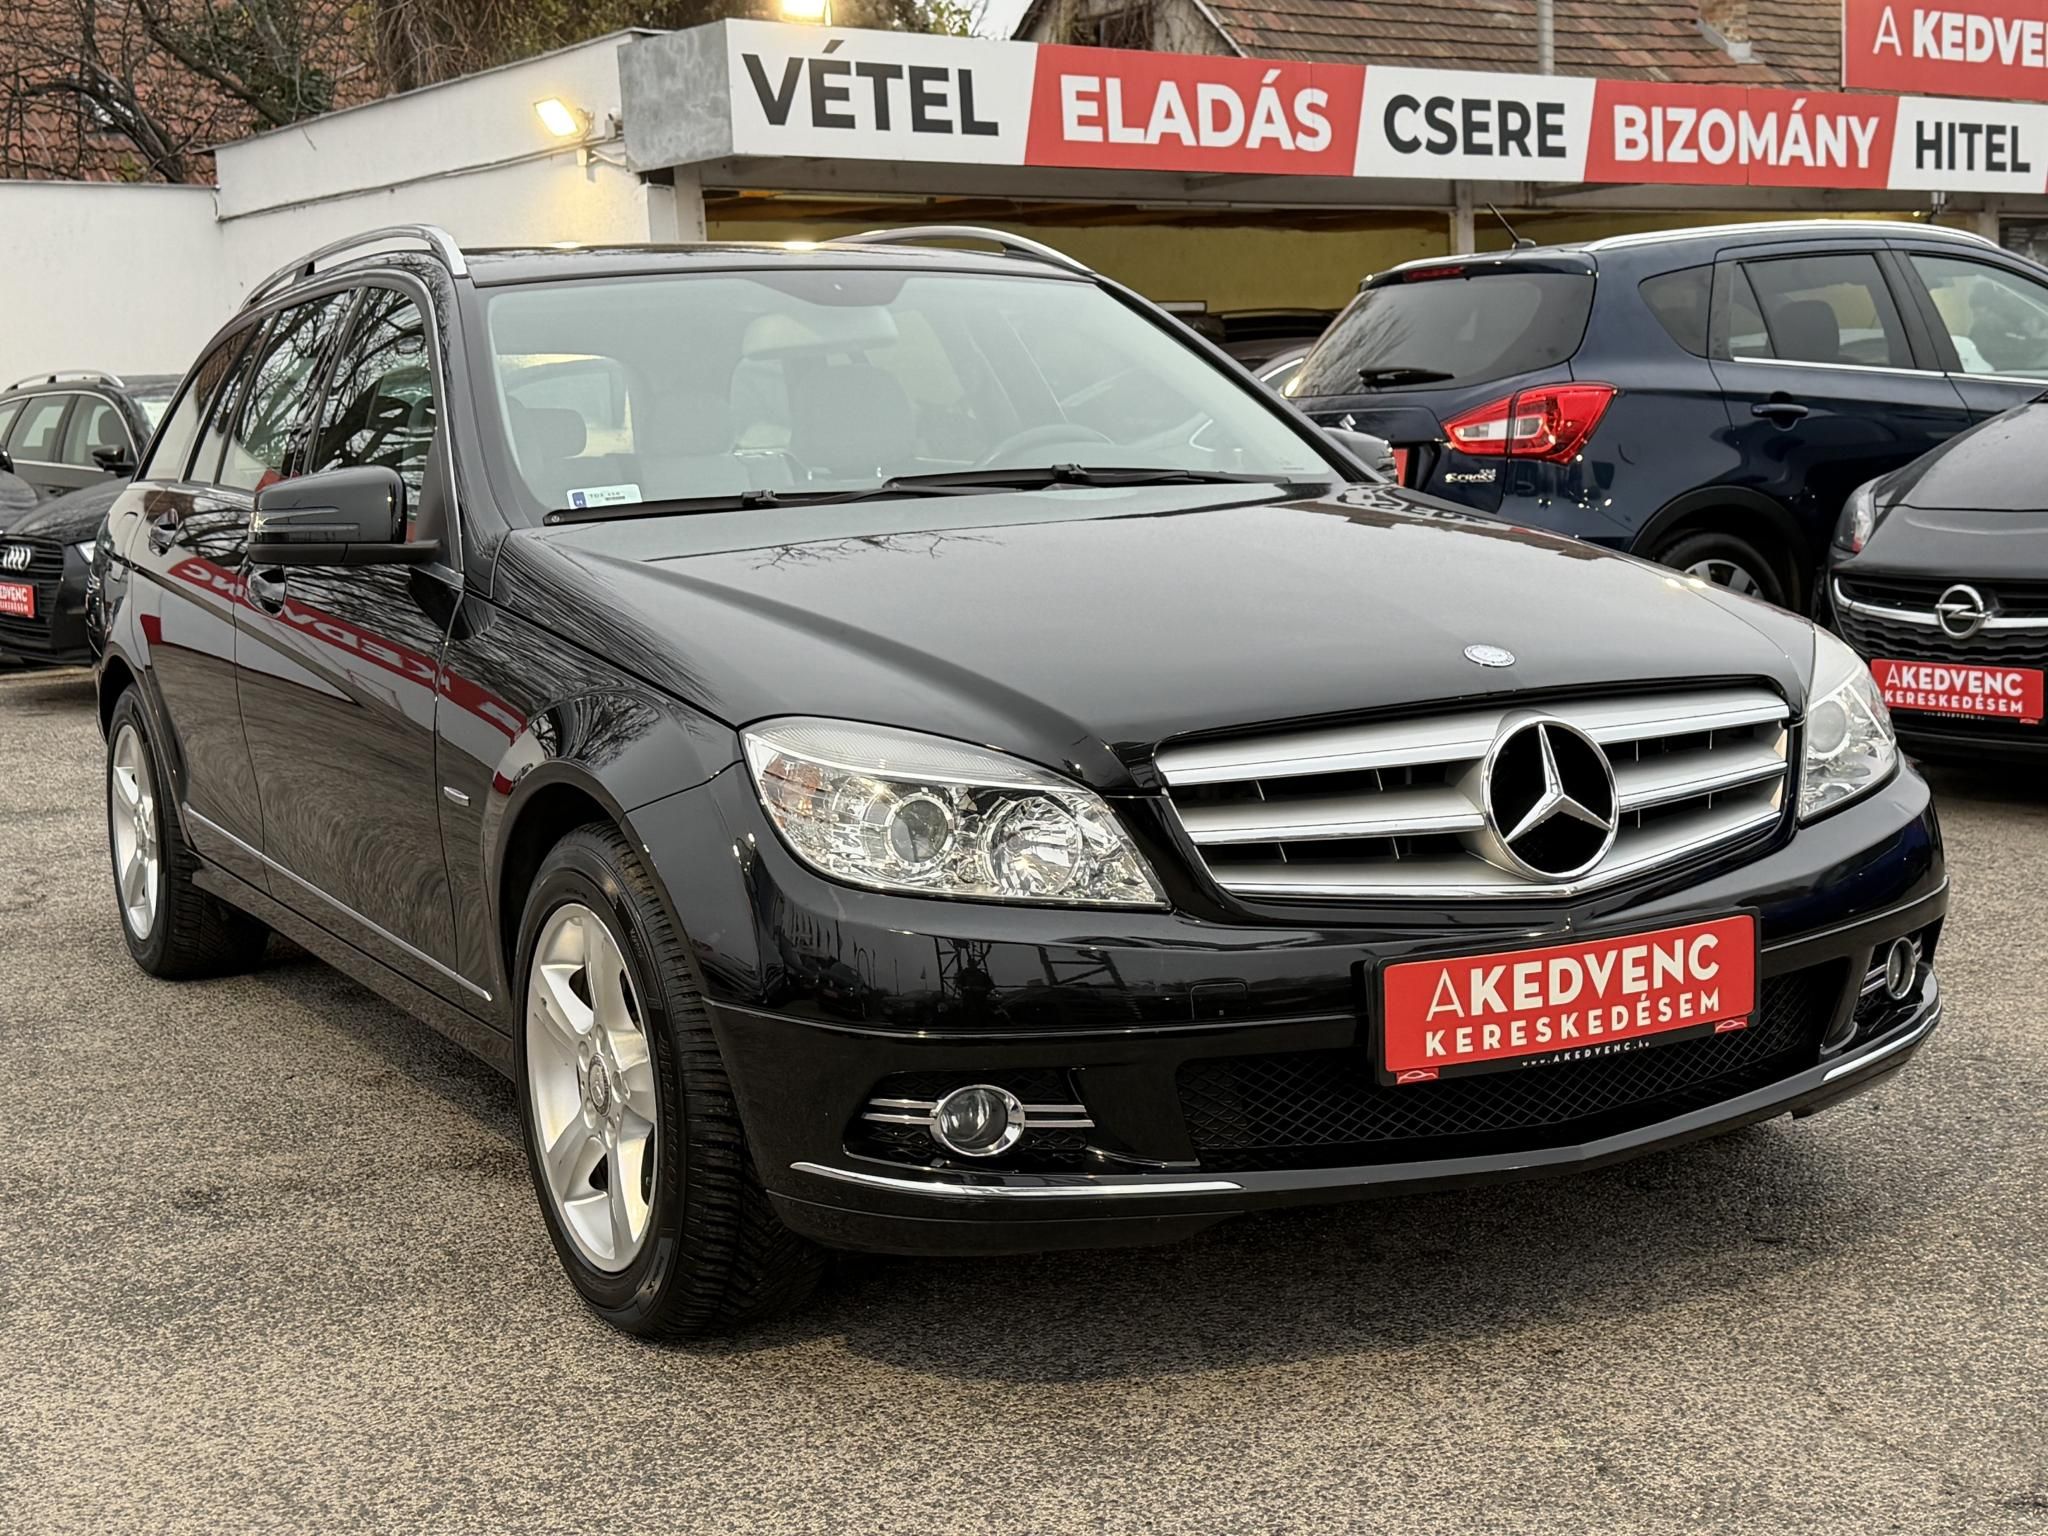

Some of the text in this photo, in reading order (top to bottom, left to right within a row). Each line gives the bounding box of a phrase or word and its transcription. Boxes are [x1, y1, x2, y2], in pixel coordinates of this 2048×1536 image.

[1873, 5, 2048, 69] A KEDVE
[742, 39, 2031, 173] VÉTEL ELADÁS CSERE BIZOMÁNY HITEL
[1884, 688, 2023, 714] KERESKEDÉSEM
[1425, 986, 1720, 1057] KERESKEDÉSEM
